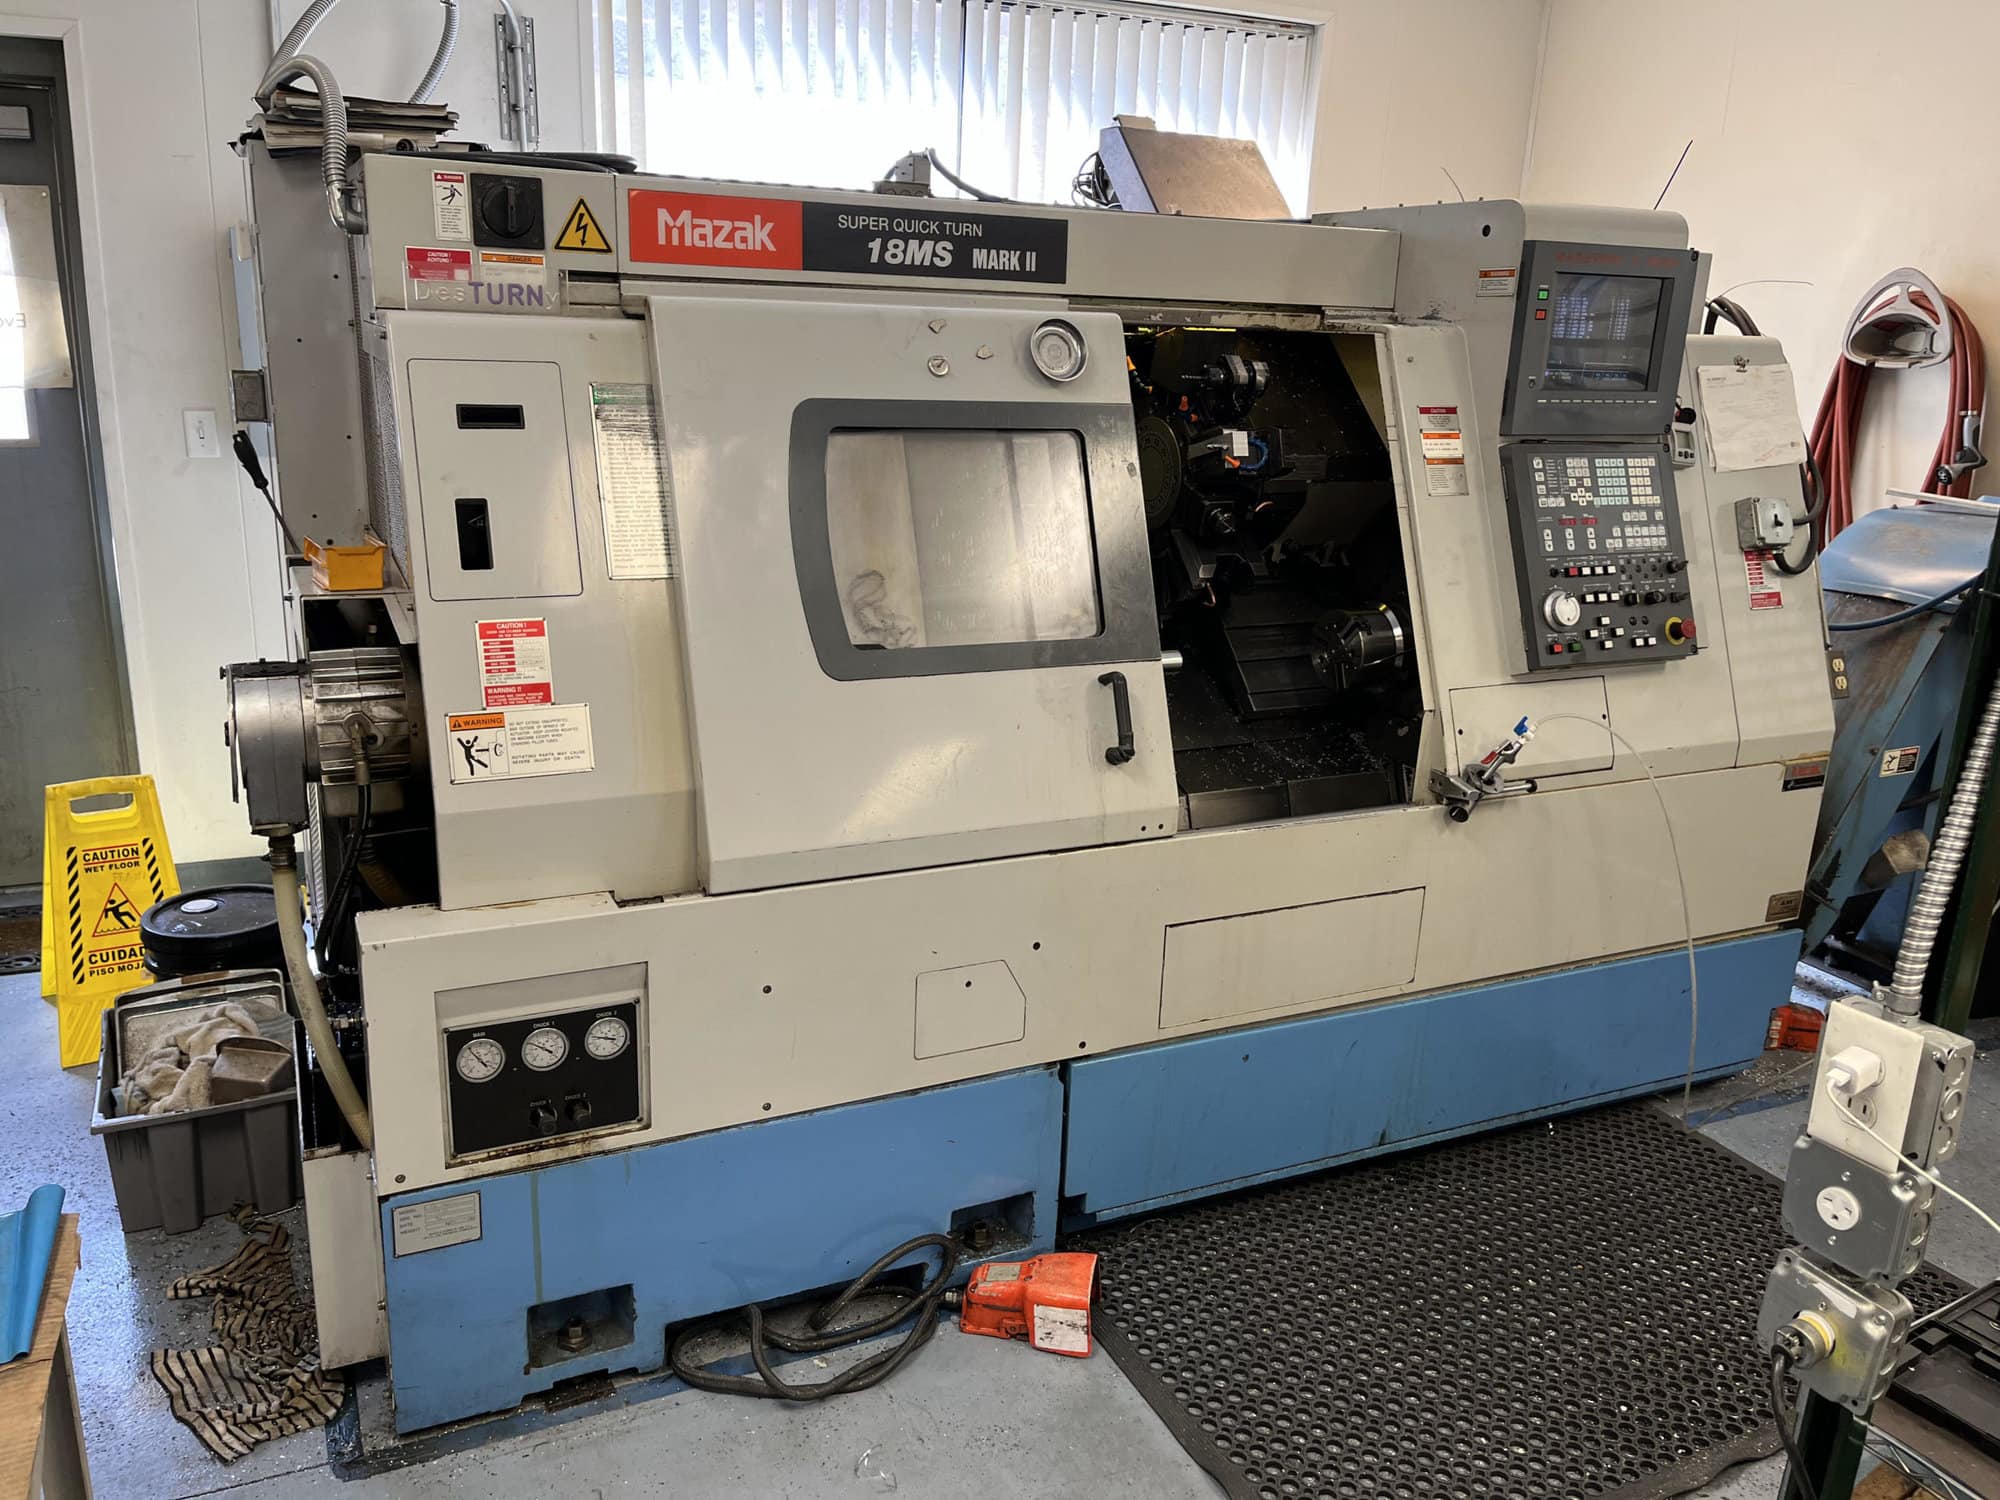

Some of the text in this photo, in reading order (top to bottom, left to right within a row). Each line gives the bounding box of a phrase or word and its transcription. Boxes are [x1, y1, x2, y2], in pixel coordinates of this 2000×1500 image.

[657, 207, 777, 252] Mazak
[838, 214, 983, 237] SUPER QUICK TURN
[867, 237, 1037, 272] 18MS MARK II
[496, 622, 524, 630] CAUTION
[487, 687, 516, 695] WARNING
[463, 717, 503, 728] WARNING
[83, 847, 140, 862] CAUTION
[84, 861, 140, 873] WET FLOOR
[88, 946, 146, 965] CUIDAD
[89, 967, 115, 977] PISO
